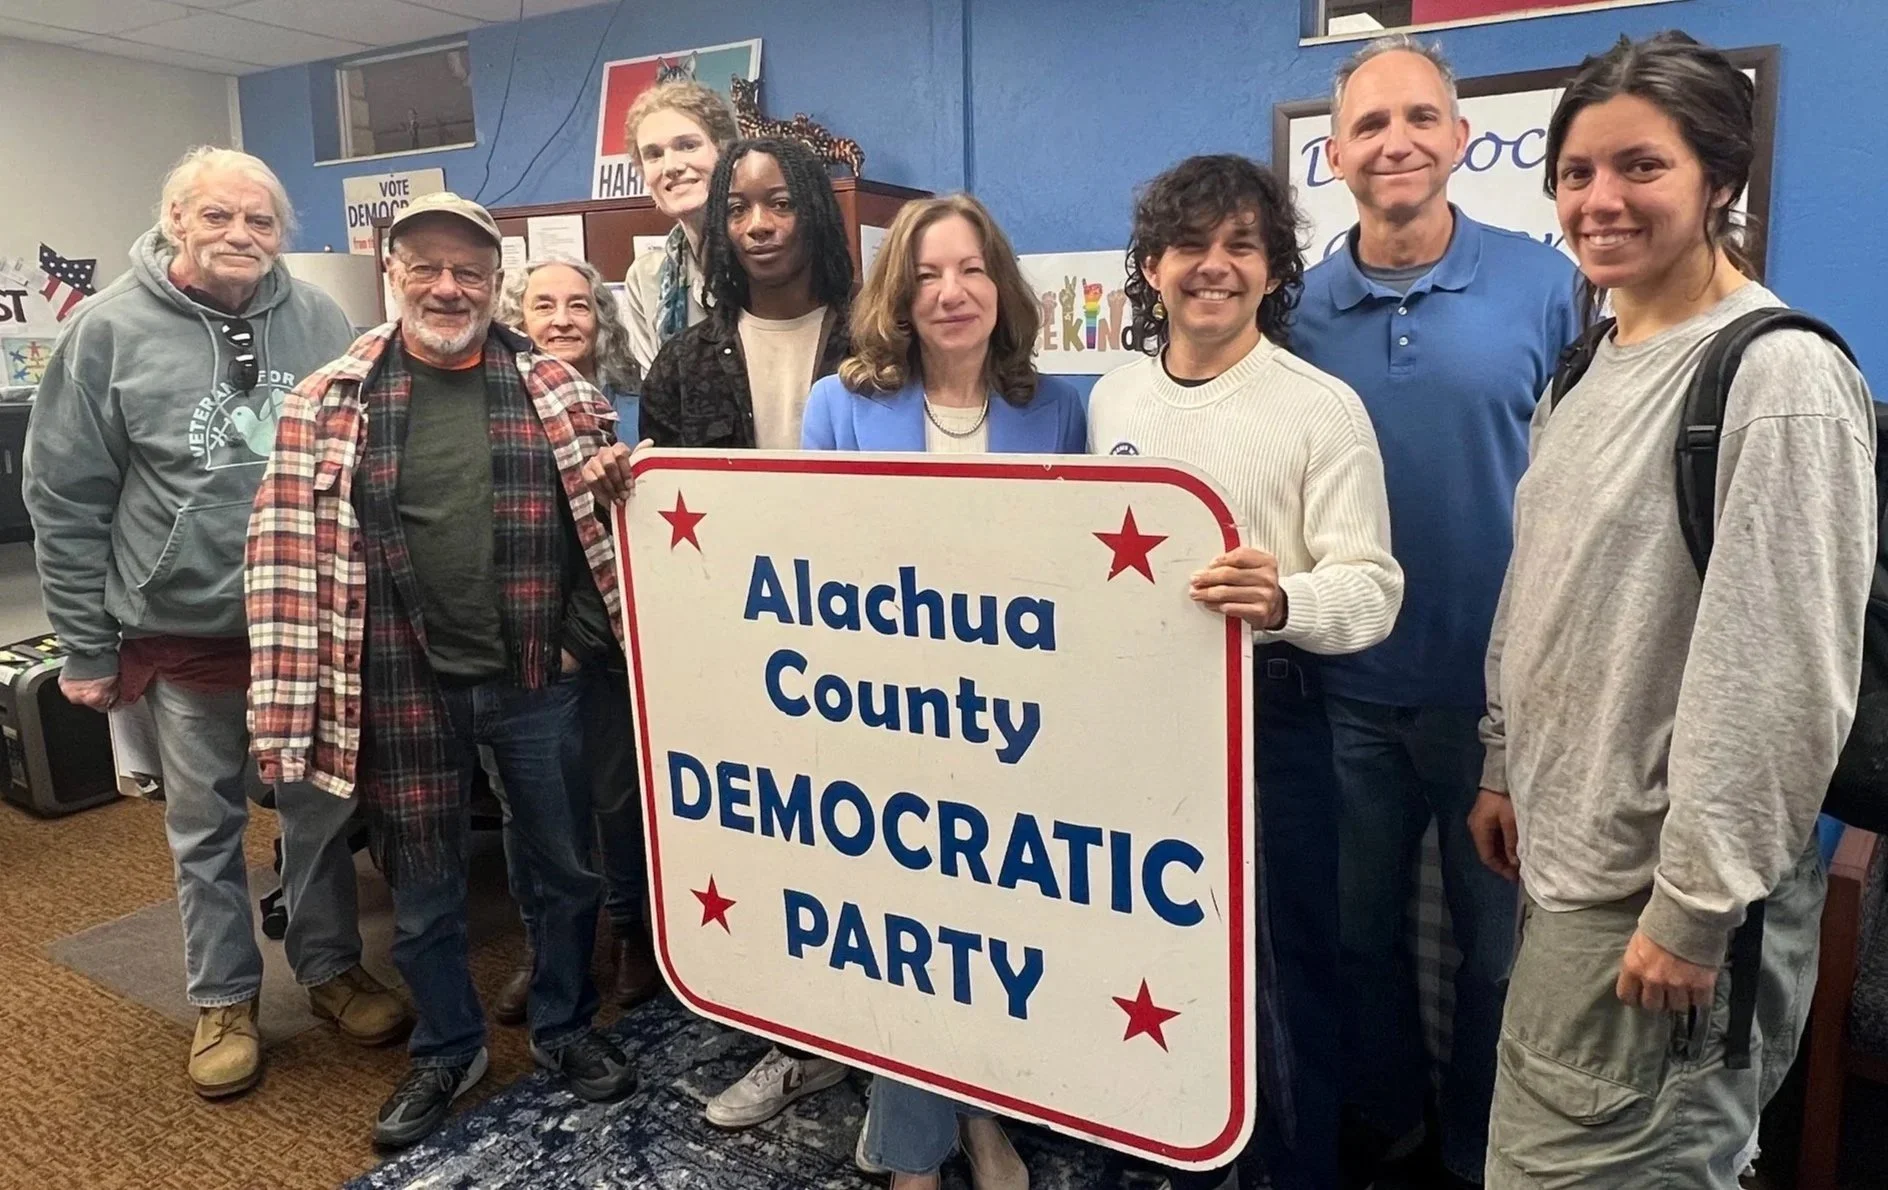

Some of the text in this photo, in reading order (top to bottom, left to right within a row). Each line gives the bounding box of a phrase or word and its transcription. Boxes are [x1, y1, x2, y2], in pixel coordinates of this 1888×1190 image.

[379, 179, 409, 197] VOTE
[257, 370, 295, 386] FOR
[744, 556, 1056, 650] Alachua
[766, 650, 1040, 763] County
[668, 752, 1205, 926] DEMOCRATIC
[783, 889, 1044, 1019] PARTY
